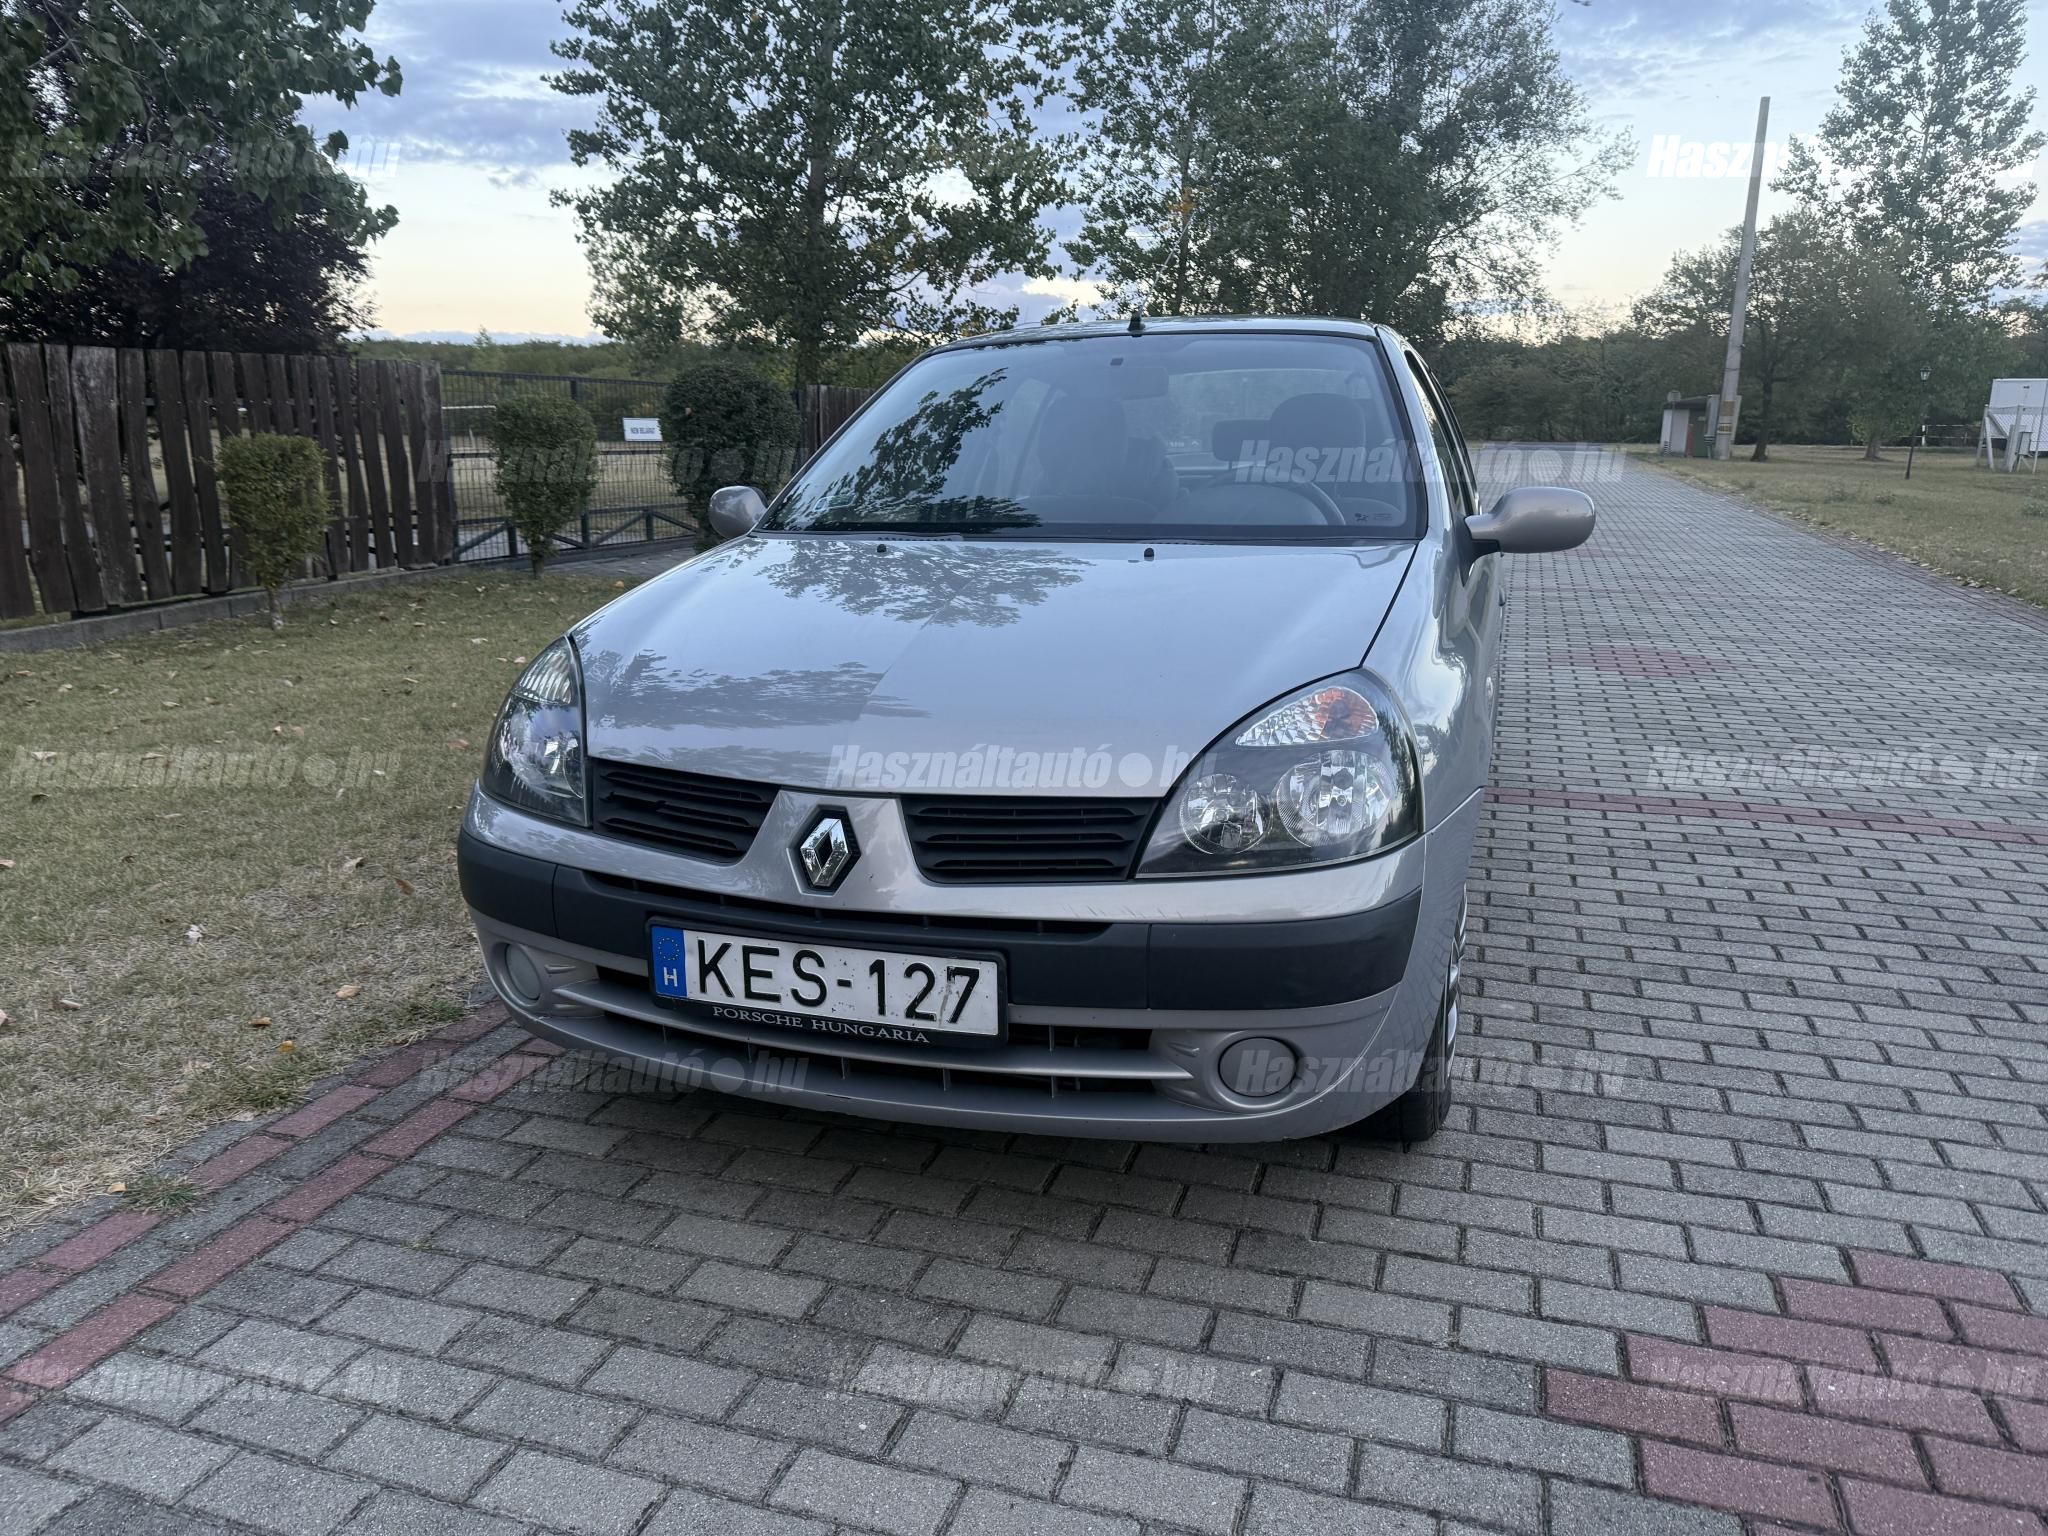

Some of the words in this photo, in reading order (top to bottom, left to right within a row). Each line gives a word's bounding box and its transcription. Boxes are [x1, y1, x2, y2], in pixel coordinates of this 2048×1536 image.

[663, 966, 678, 987] H
[697, 938, 980, 1024] KES-127
[712, 1006, 803, 1028] PORSCHE
[811, 1019, 930, 1043] HUNGARIA
